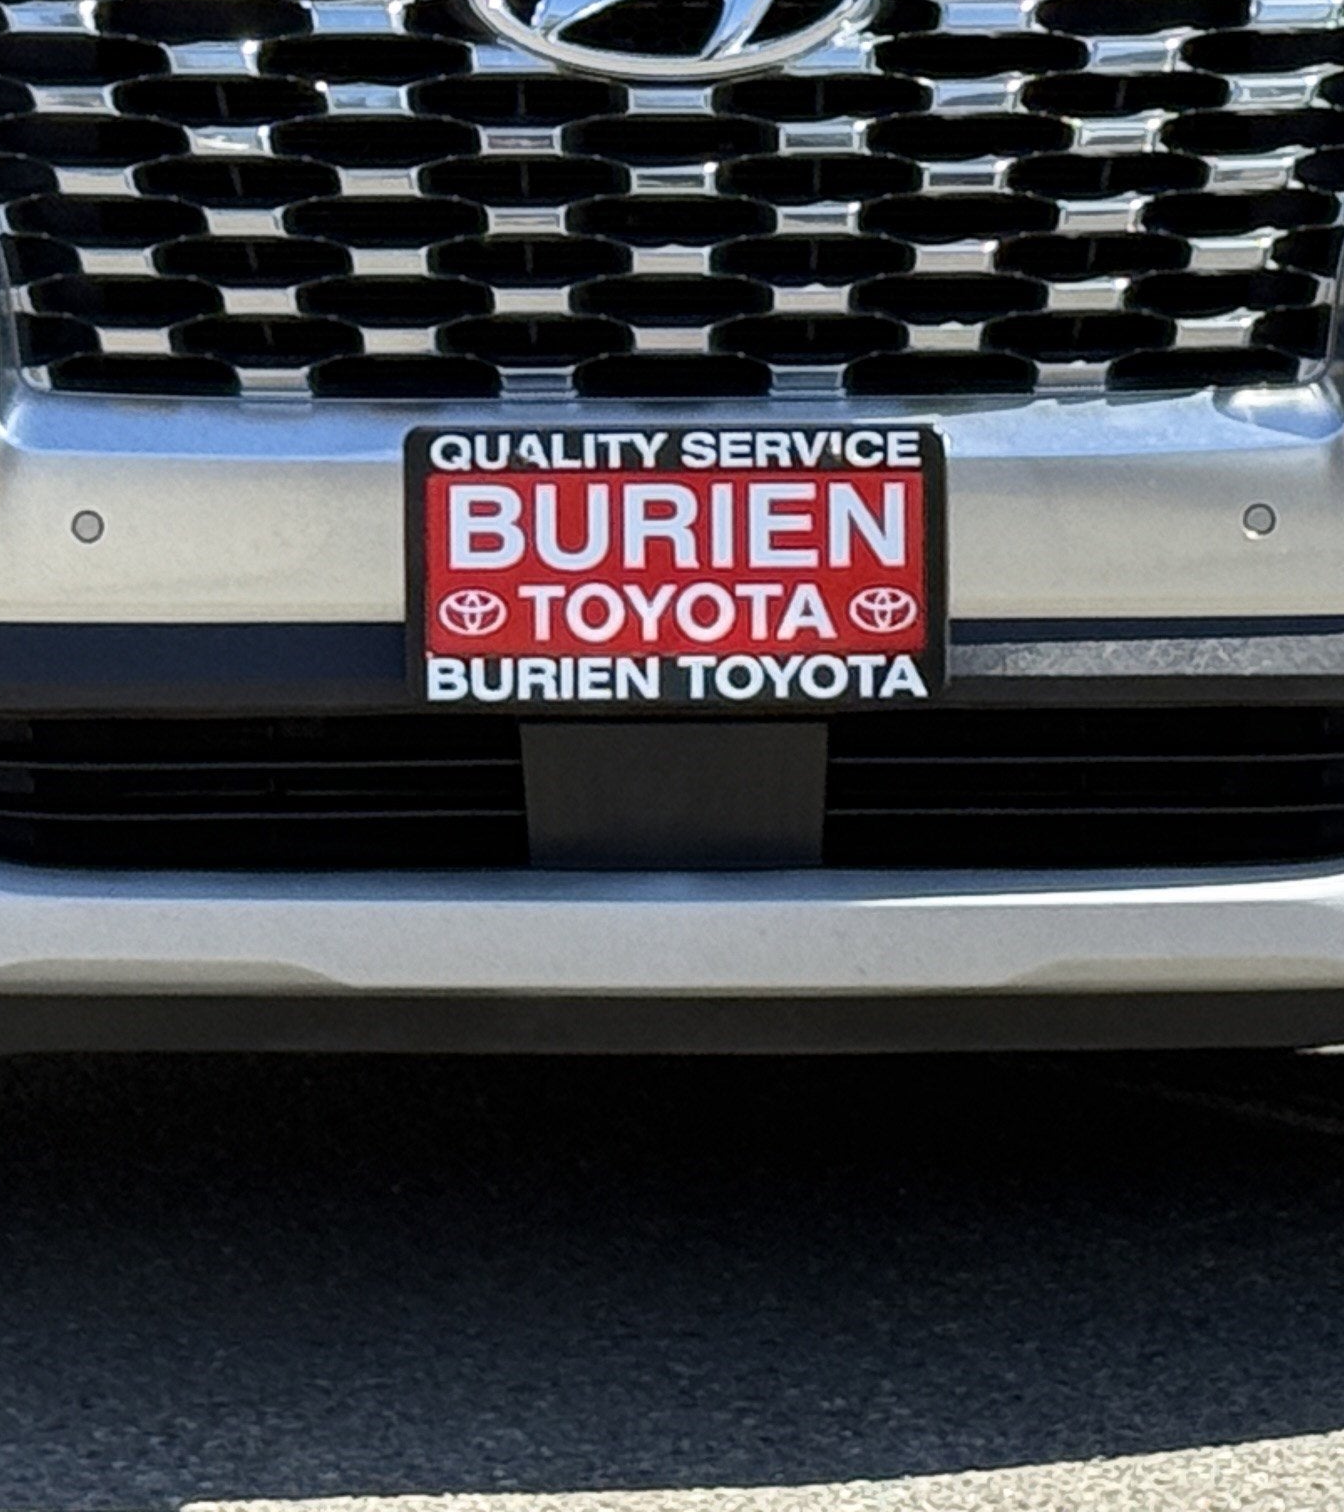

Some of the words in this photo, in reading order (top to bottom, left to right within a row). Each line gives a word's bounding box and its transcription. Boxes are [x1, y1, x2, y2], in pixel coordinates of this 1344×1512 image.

[430, 432, 668, 471] QUALITY
[681, 431, 922, 469] SERVICE
[448, 481, 906, 571] BURIEN
[518, 581, 838, 642] TOYOTA
[427, 656, 660, 700] BURIEN
[678, 654, 929, 699] TOYOTA
